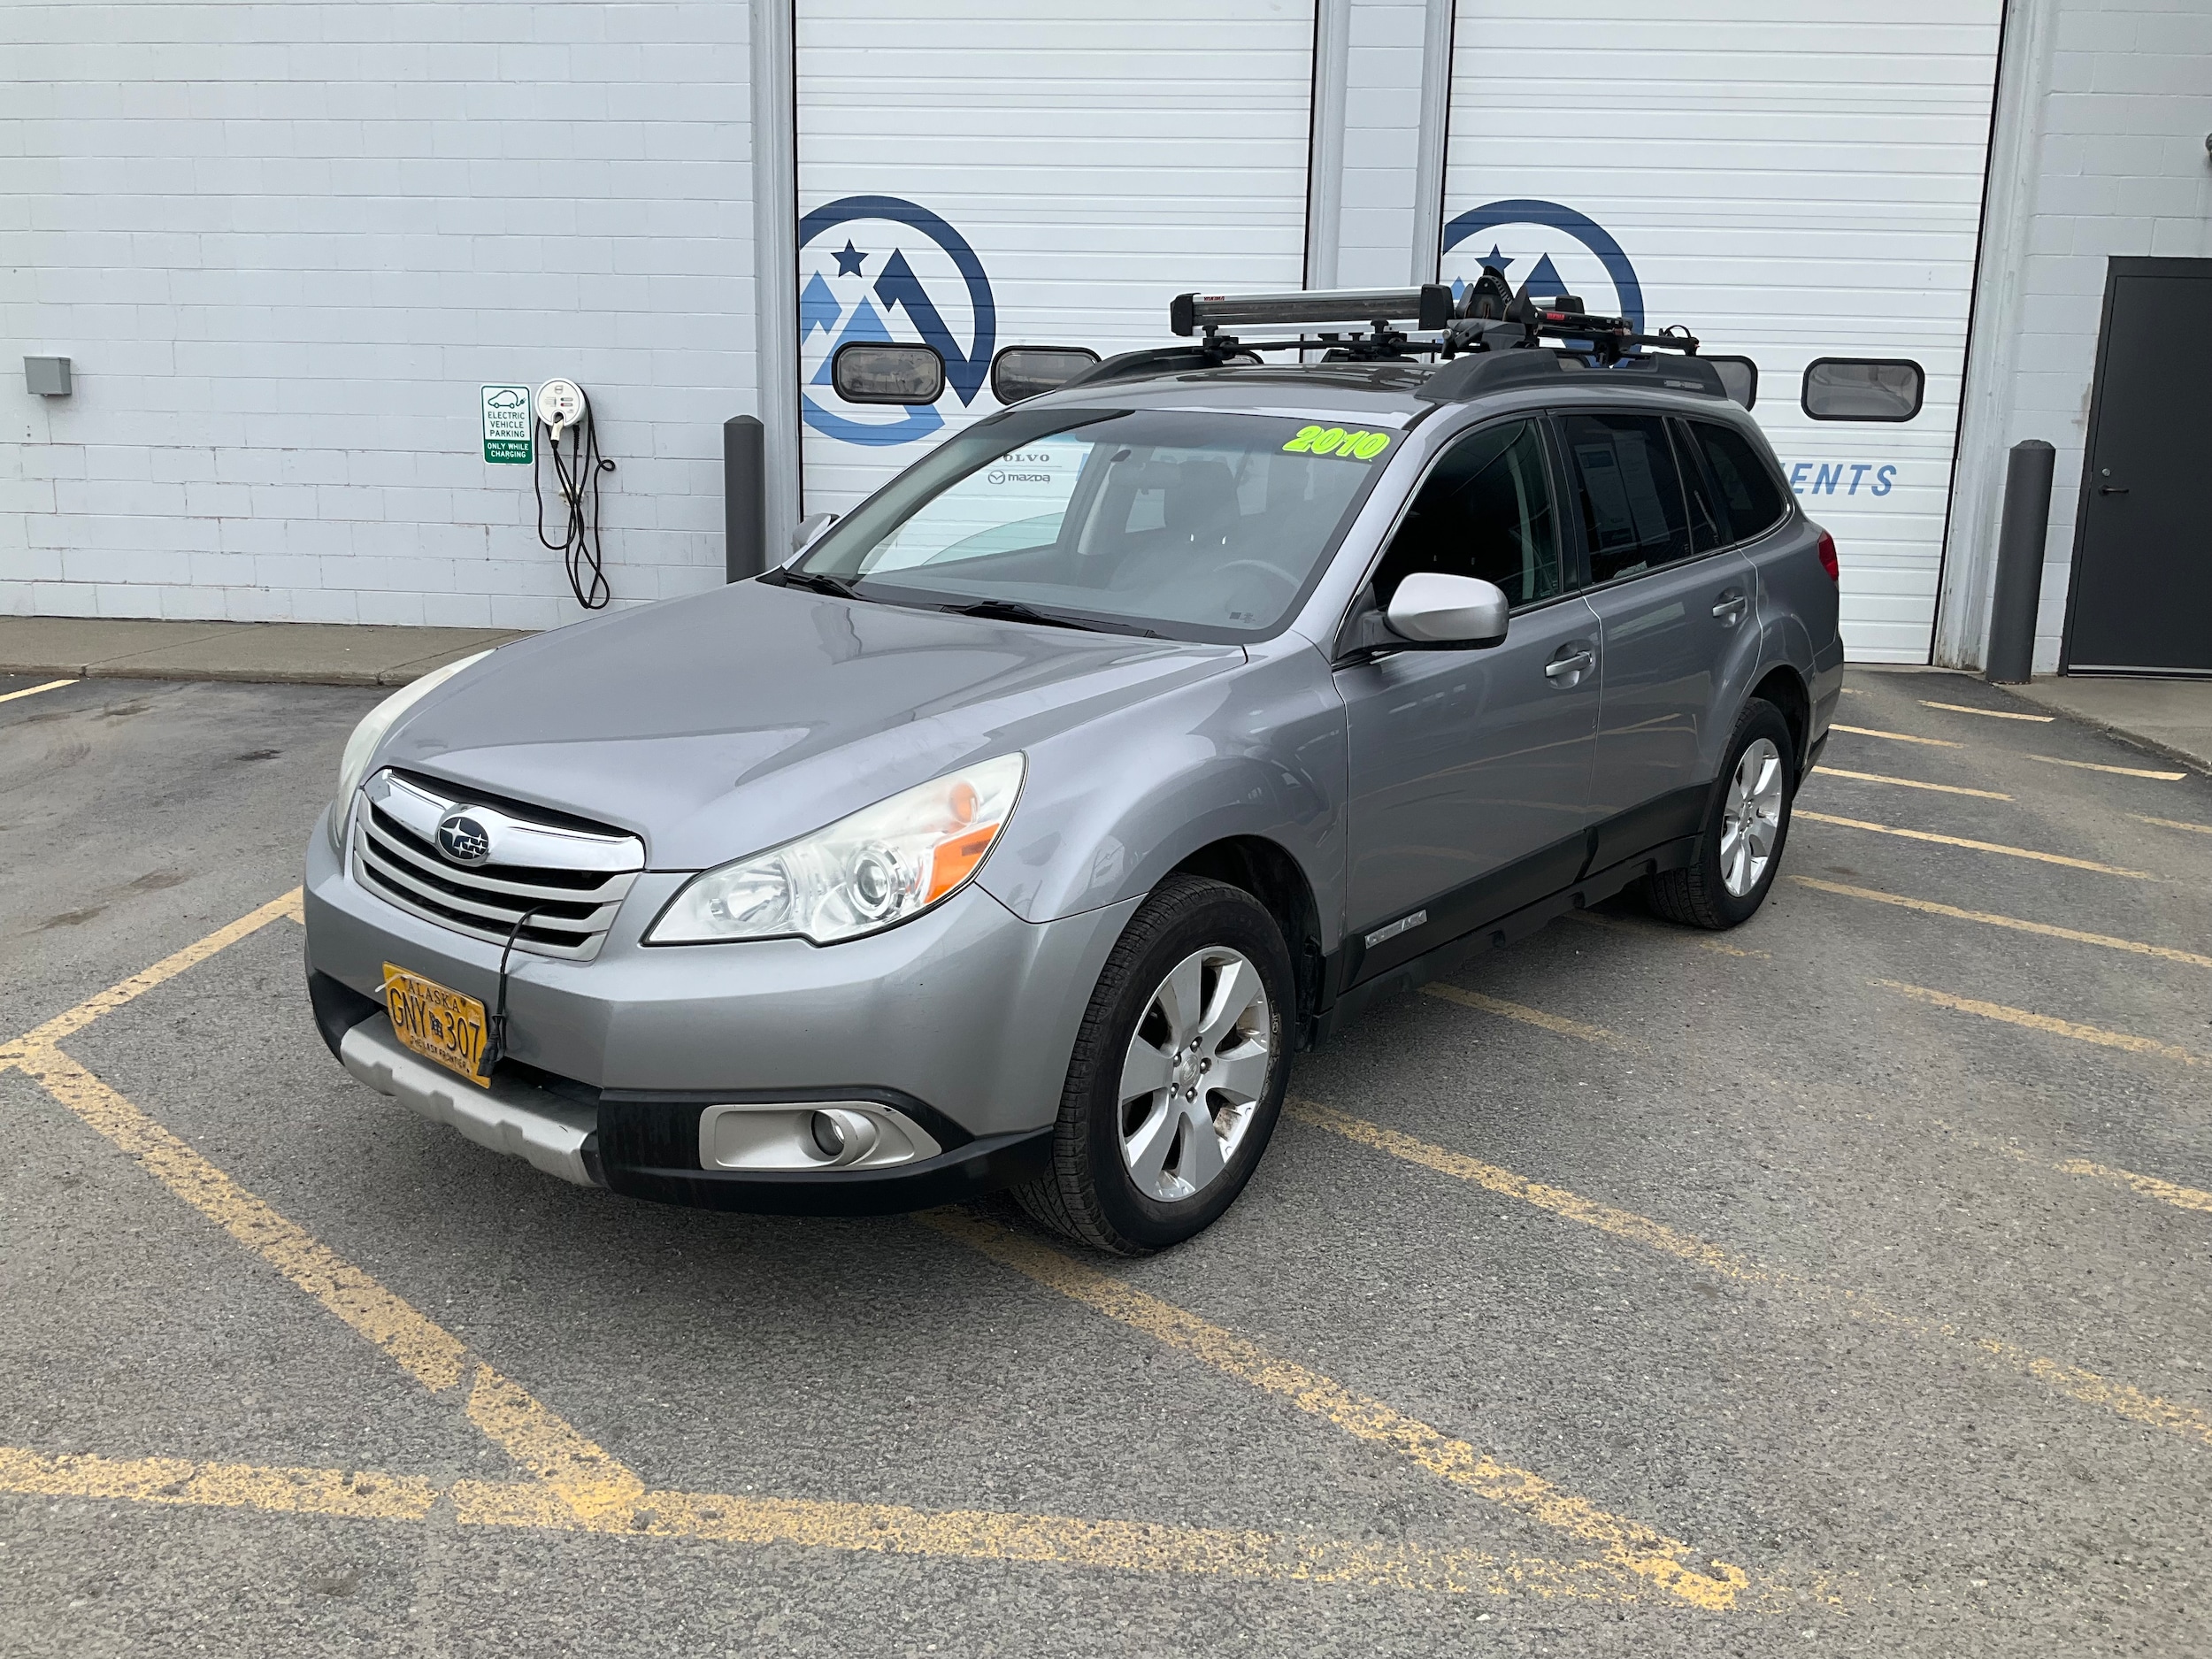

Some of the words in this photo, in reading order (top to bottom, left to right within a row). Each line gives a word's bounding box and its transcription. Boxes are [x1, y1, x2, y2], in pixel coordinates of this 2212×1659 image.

[489, 429, 526, 438] PARKING
[490, 420, 525, 429] VEHICLE
[1282, 426, 1391, 460] 2010
[1780, 463, 1897, 496] ENTS
[407, 979, 461, 1014] ALASKA
[390, 987, 426, 1039] GNY
[445, 1011, 480, 1064] 307
[410, 1035, 422, 1048] THE
[423, 1042, 438, 1055] LAST
[439, 1048, 467, 1068] FRONTIER
